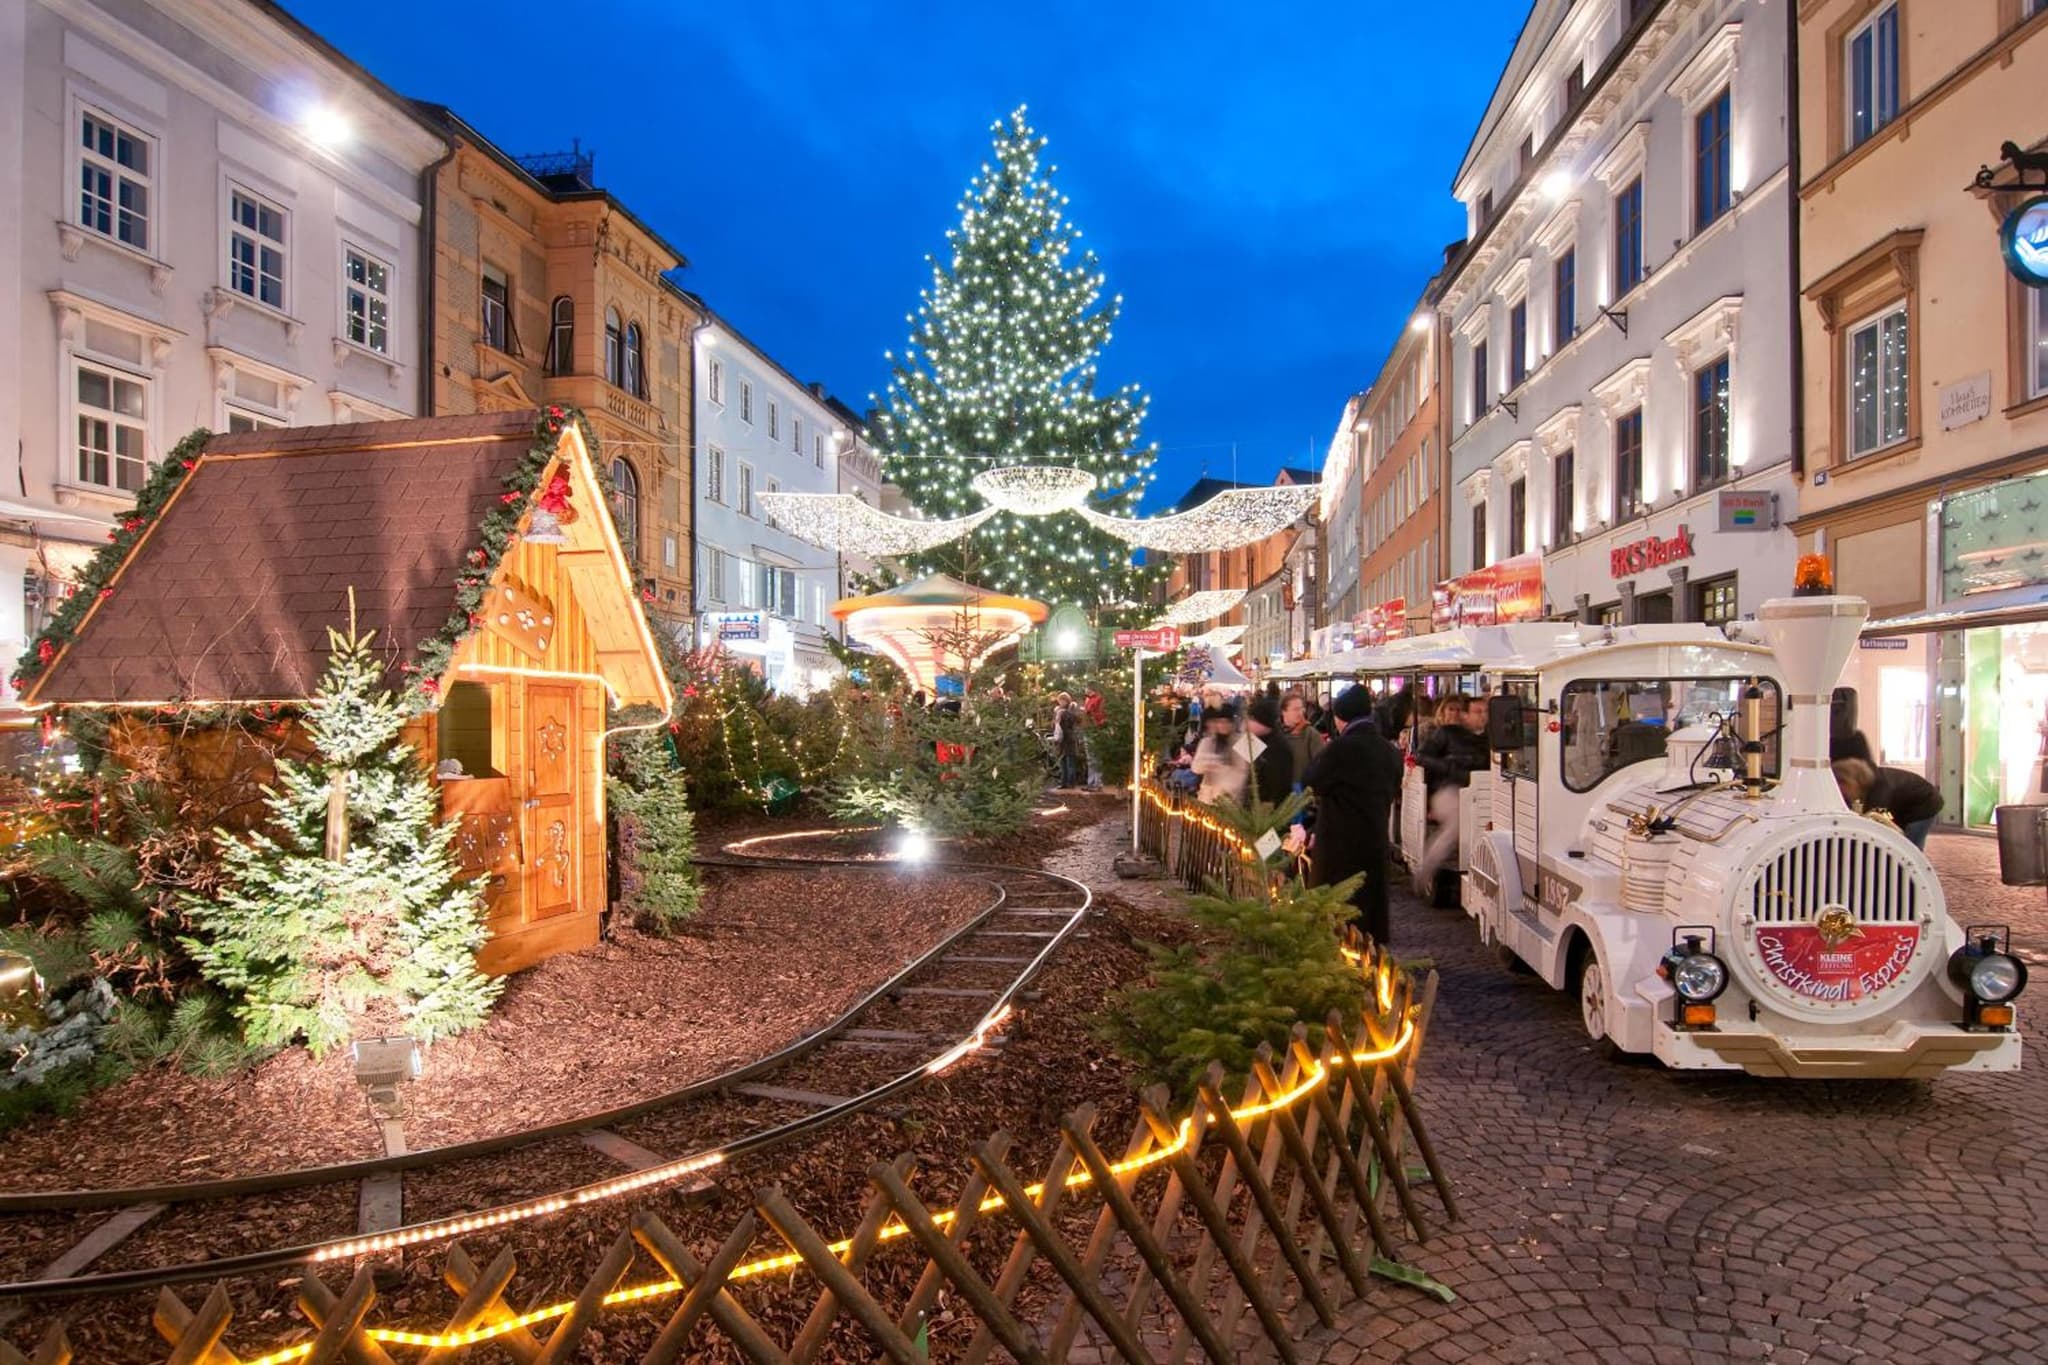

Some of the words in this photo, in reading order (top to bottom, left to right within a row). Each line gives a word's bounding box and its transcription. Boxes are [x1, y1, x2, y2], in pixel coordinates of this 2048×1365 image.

[1611, 540, 1645, 579] BKS
[1645, 524, 1694, 569] Bank
[1760, 936, 1848, 1000] Christkindl
[1859, 934, 1914, 994] Express
[1819, 953, 1853, 963] KLEINE
